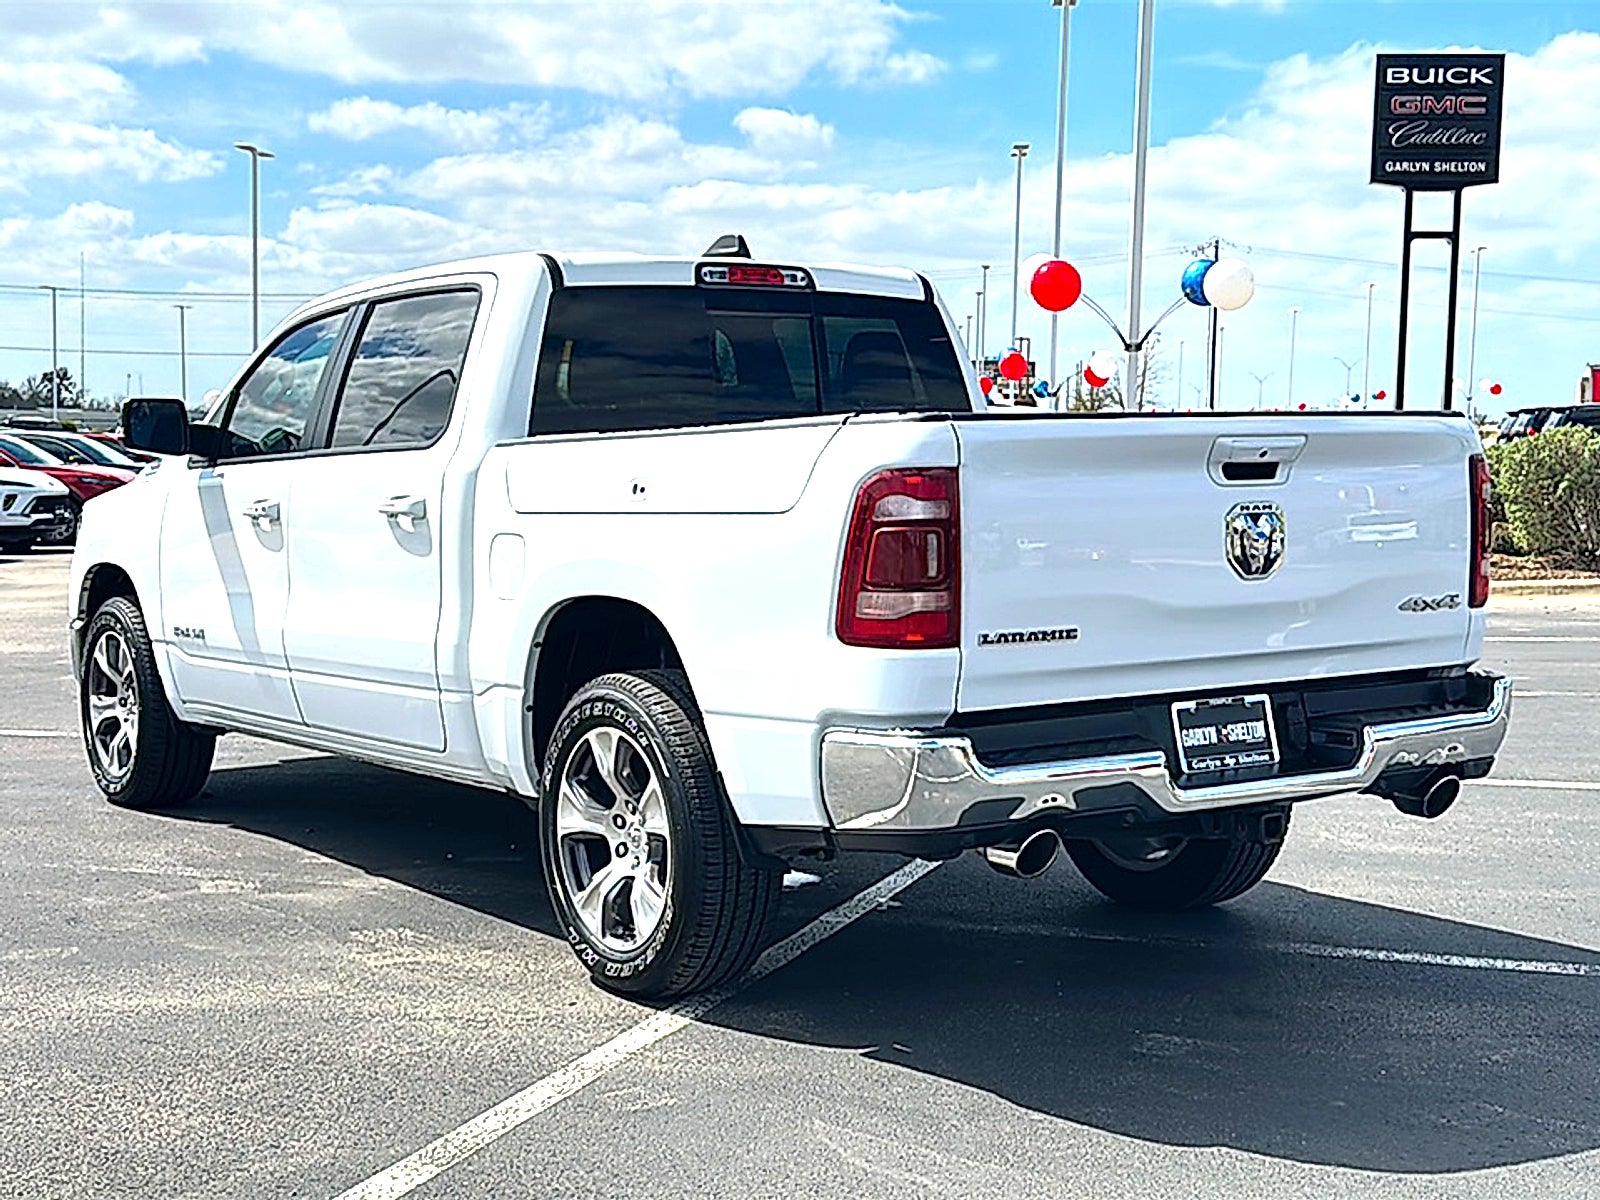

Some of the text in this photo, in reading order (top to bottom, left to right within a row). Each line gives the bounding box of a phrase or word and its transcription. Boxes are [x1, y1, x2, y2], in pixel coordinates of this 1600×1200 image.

[1386, 67, 1494, 84] BUICK
[1390, 95, 1487, 114] GMC
[1388, 120, 1487, 148] Cadillac
[1385, 161, 1486, 172] GARLYN SHELTON
[978, 628, 1078, 647] LARAMIE
